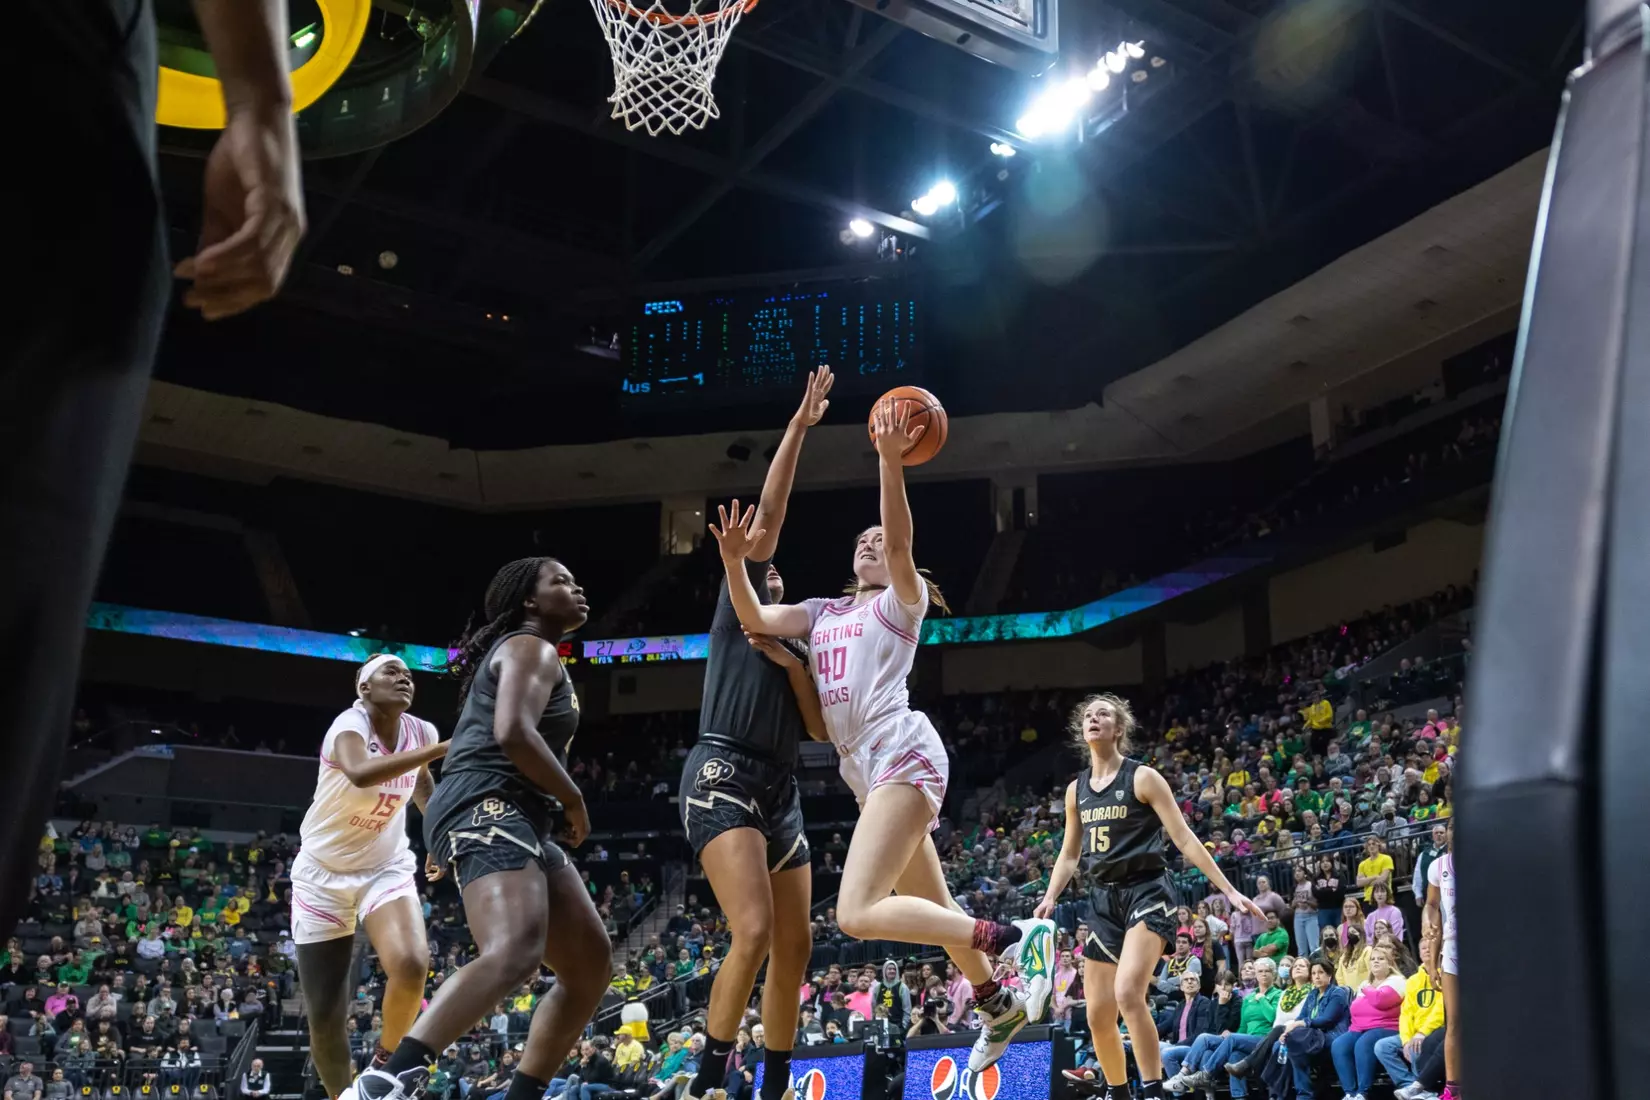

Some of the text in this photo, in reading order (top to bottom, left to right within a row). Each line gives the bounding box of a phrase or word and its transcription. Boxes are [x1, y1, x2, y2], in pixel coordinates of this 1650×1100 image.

[817, 646, 847, 684] 40
[370, 792, 402, 818] 15
[1080, 805, 1128, 824] COLORADO
[1089, 826, 1110, 853] 15
